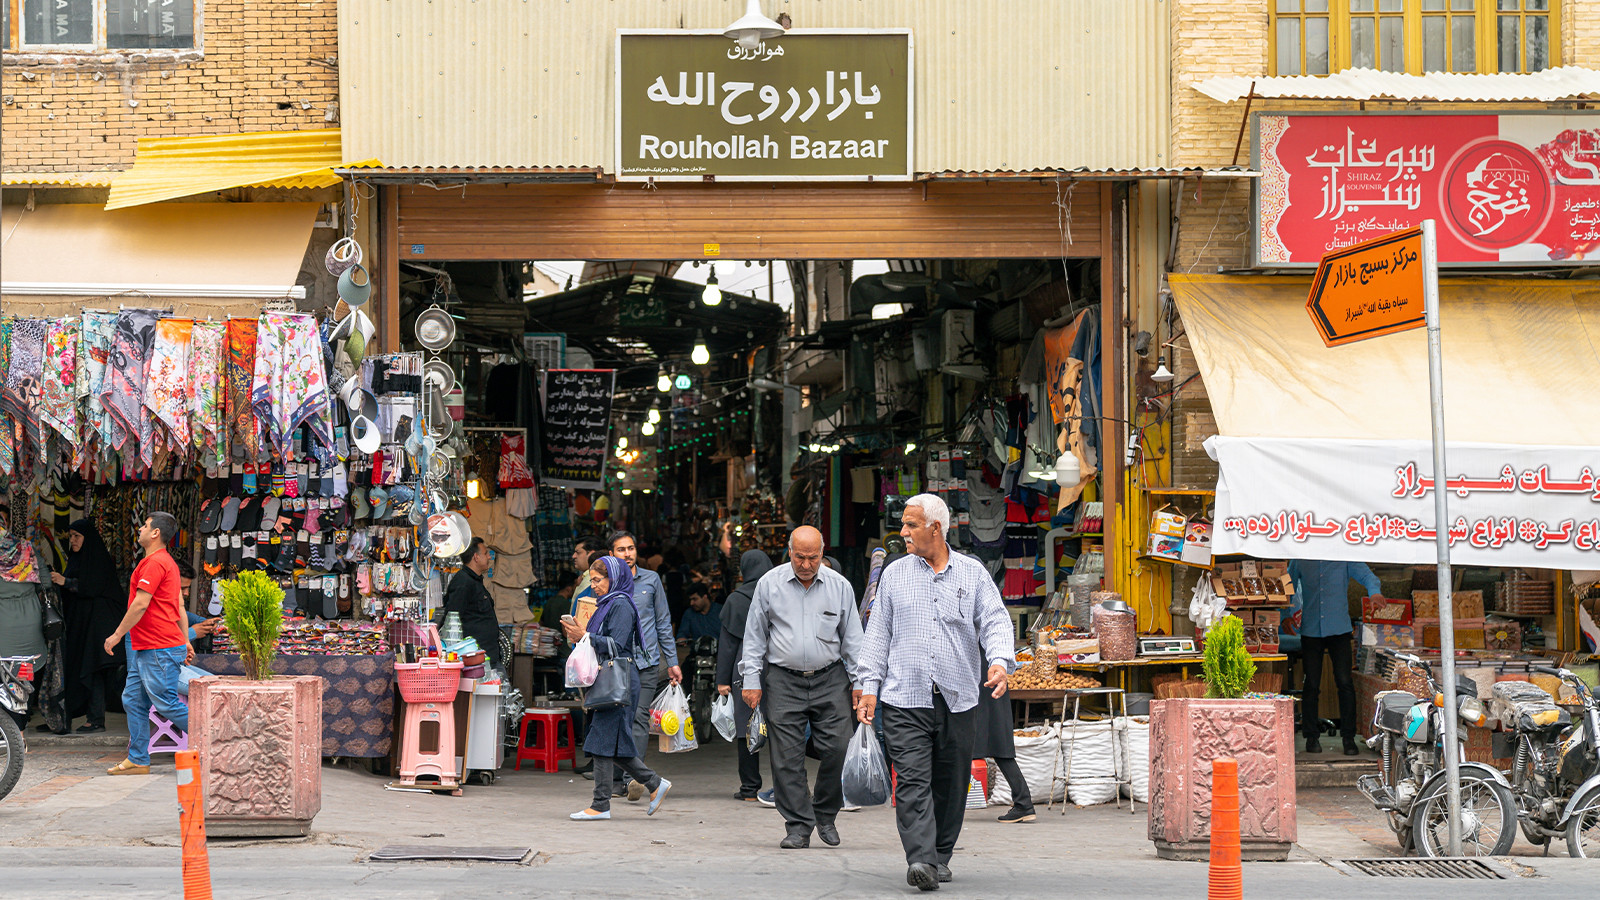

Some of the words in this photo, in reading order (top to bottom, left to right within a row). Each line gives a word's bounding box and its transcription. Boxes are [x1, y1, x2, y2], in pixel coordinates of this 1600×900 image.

[647, 71, 715, 106] الله
[799, 70, 881, 123] بازار
[721, 82, 801, 125] روح
[639, 135, 778, 159] Rouhollah
[790, 135, 888, 159] Bazaar
[1305, 125, 1435, 182] سوغات
[1314, 165, 1421, 221] شیراز
[1334, 220, 1355, 234] برتر
[1357, 216, 1410, 232] نمایندگی
[1360, 259, 1389, 285] بسیج
[1391, 246, 1418, 274] مرکز
[1333, 262, 1357, 288] بازار
[1345, 305, 1363, 322] شیراز
[1367, 301, 1376, 313] الله
[1392, 296, 1408, 311] سپاه
[589, 389, 605, 400] کیف
[1392, 465, 1515, 496] شیراز
[1248, 513, 1286, 539] ارده
[1289, 513, 1340, 540] حلوا
[1345, 516, 1388, 543] انواع
[1406, 518, 1468, 545] شرت
[1471, 518, 1516, 546] انواع
[1535, 520, 1573, 547] گز
